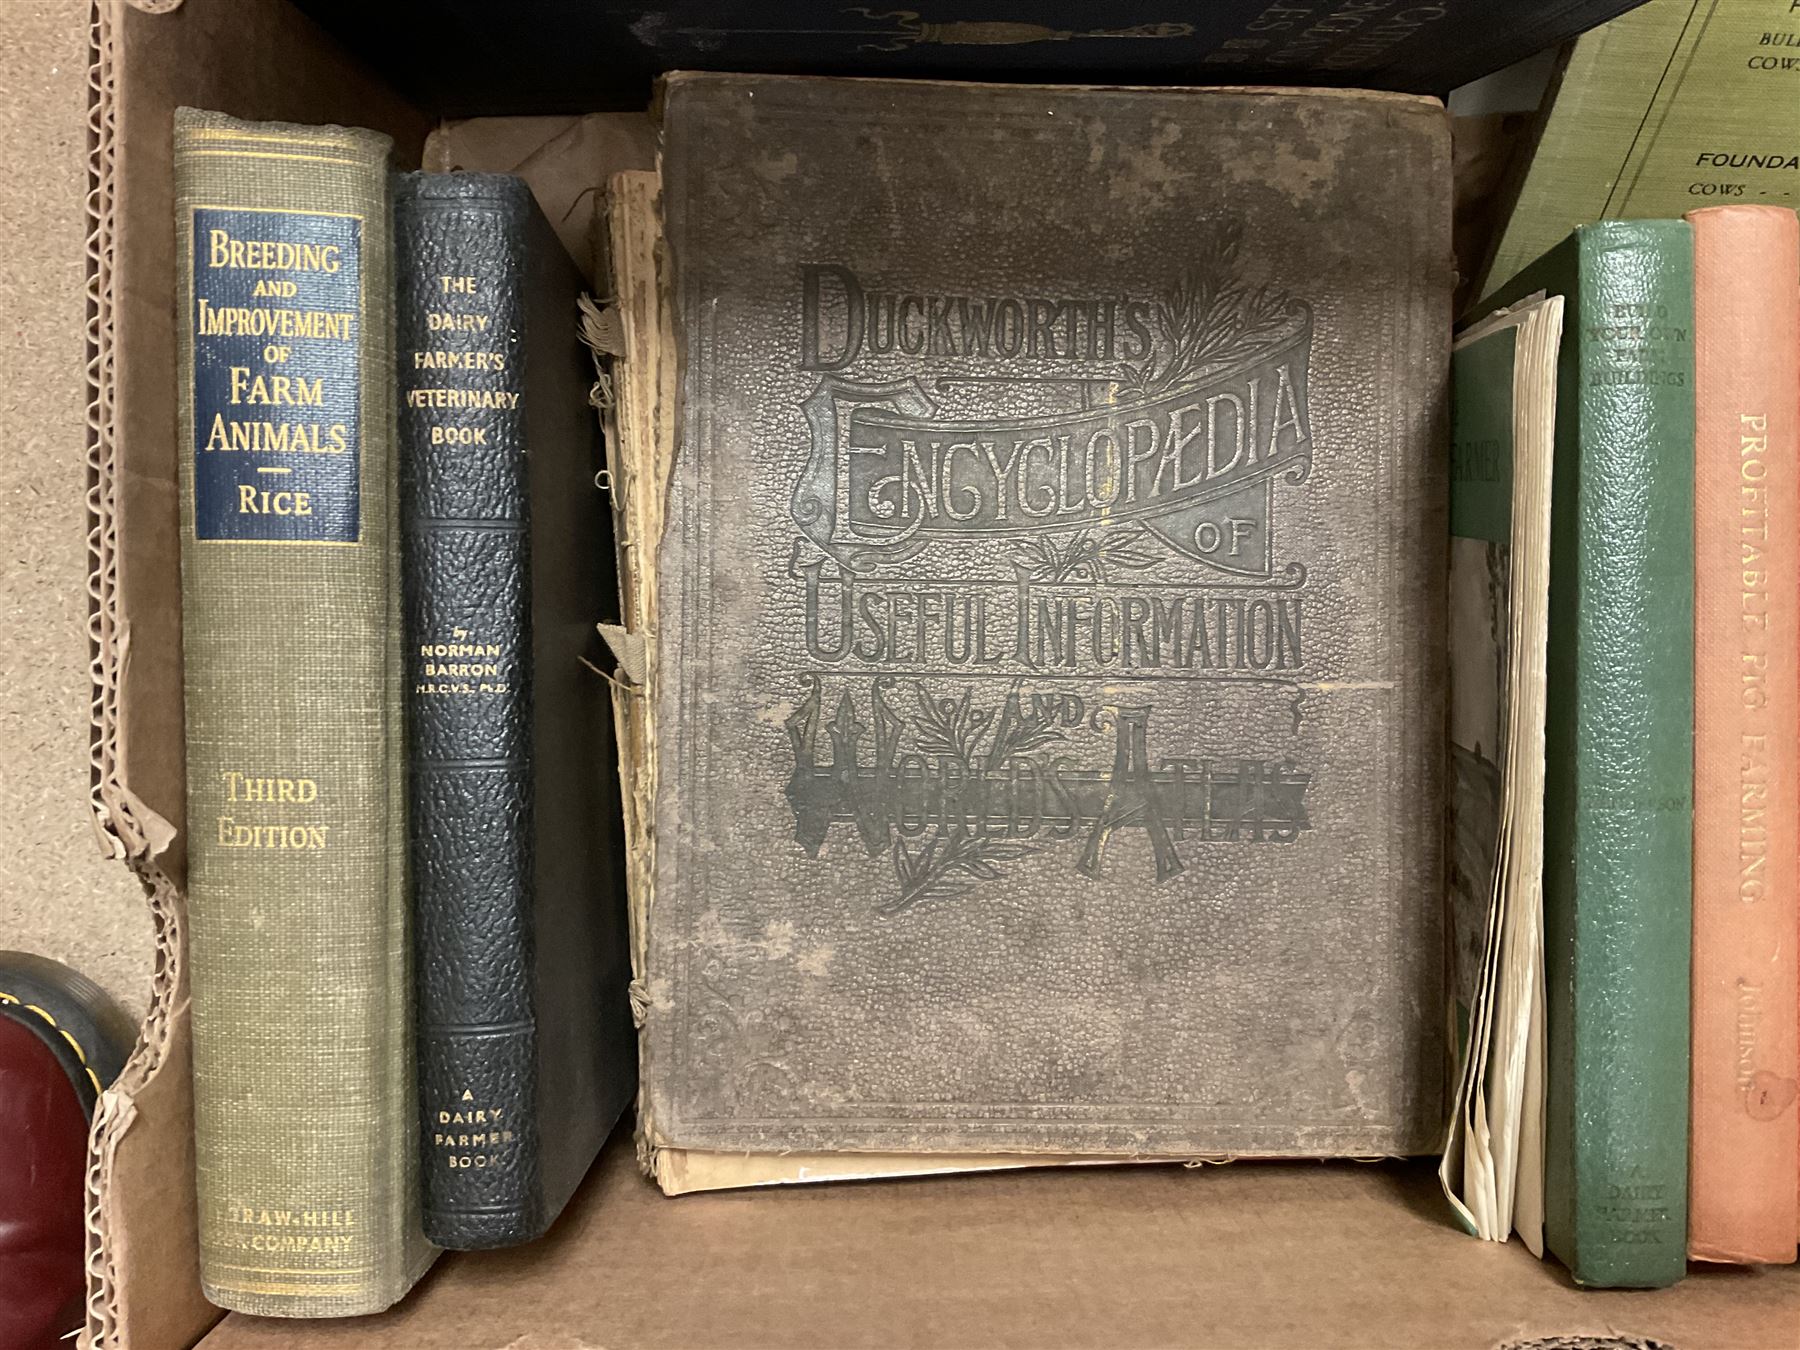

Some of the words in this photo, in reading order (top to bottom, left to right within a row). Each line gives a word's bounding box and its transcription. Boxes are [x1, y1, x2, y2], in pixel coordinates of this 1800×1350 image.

[1696, 152, 1799, 170] FOUNDA
[1688, 183, 1746, 197] COWS
[209, 229, 341, 273] BREEDING
[253, 280, 297, 298] AND
[440, 276, 477, 294] THE
[198, 299, 353, 340] IMPROVEMENT
[428, 313, 489, 331] DAIRY
[801, 263, 1155, 373] DUCKWORTH'S
[263, 345, 291, 363] OF
[414, 351, 505, 370] FARMER'S
[230, 367, 324, 406] FARM
[407, 389, 520, 410] VETERINARY
[205, 413, 346, 454] ANIMALS
[431, 426, 487, 445] BOOK
[238, 485, 312, 516] RICE
[1740, 413, 1769, 632] PROFITABLE
[1192, 518, 1258, 556] OF
[804, 554, 1000, 665] USEFUL
[1008, 554, 1306, 670] INFORMATION
[421, 645, 500, 657] NORMAN
[425, 664, 497, 676] BARRON
[1741, 652, 1768, 711] PIG
[222, 771, 318, 804] THIRD
[1740, 732, 1768, 905] FARMING
[216, 815, 330, 850] EDITION
[462, 1089, 474, 1101] A
[439, 1109, 502, 1124] DAIRY
[435, 1131, 513, 1148] FARMER
[449, 1155, 499, 1168] BOOK
[251, 1234, 353, 1253] COMPANY
